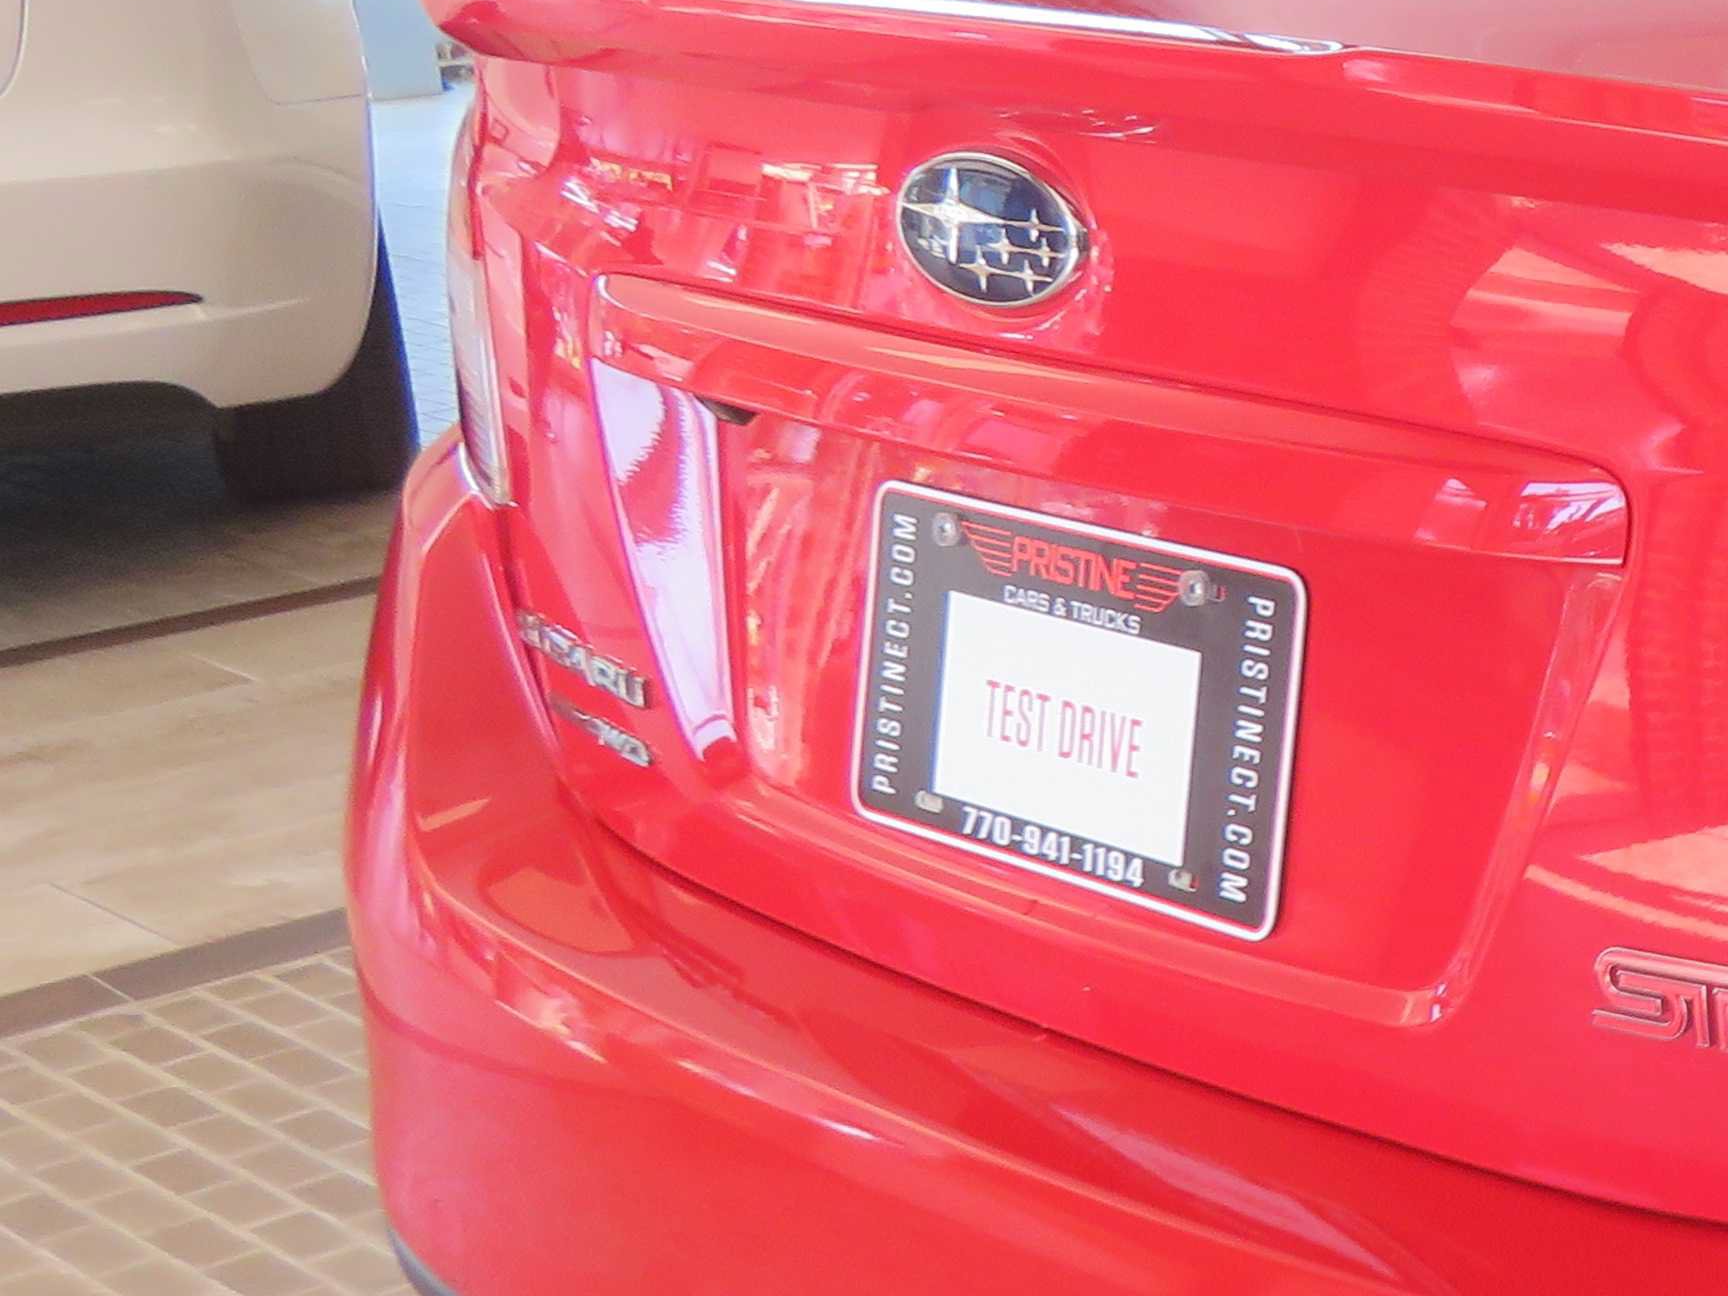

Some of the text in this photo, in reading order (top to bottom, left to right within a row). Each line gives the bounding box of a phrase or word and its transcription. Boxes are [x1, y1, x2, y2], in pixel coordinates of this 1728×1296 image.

[1002, 583, 1142, 636] CARS & TRUCKS
[1010, 534, 1138, 601] PRISTINE
[872, 513, 919, 795] PRISTINECT.COM
[985, 678, 1144, 779] TEST DRIVE
[1219, 595, 1276, 904] PRISTINECT.COM
[960, 805, 1145, 889] 770-941-1194
